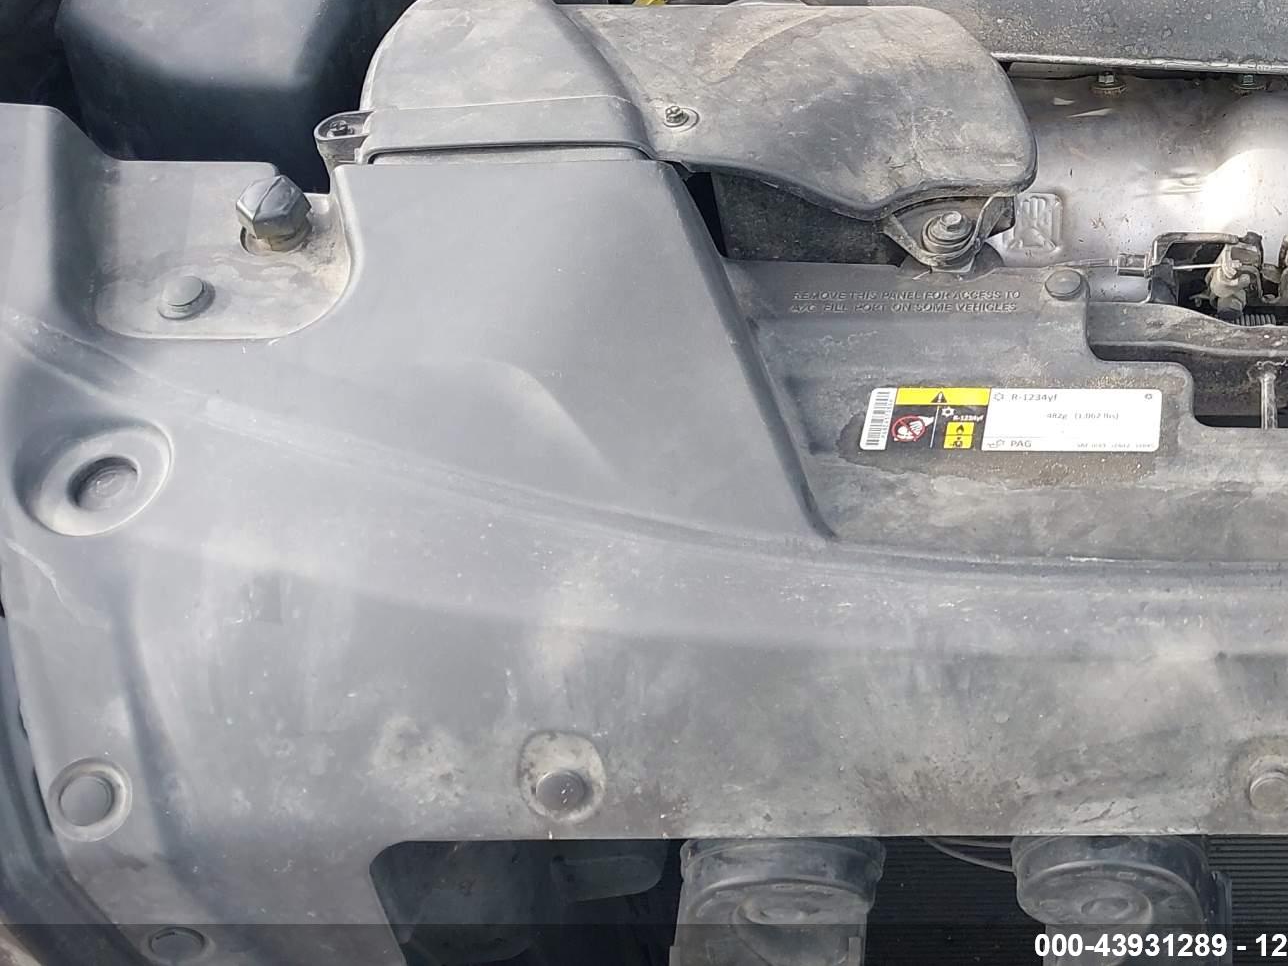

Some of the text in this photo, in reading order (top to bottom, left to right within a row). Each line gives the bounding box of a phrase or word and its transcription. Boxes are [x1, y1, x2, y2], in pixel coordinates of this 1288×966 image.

[793, 290, 1021, 301] REMOVE THIS PANEL FOR ACCESS TO
[823, 302, 848, 313] FILL
[891, 302, 911, 313] ON
[914, 302, 952, 313] SOME
[955, 302, 1018, 313] VEHICLES
[1011, 393, 1058, 403] R-1234yf
[1010, 439, 1032, 448] PAG
